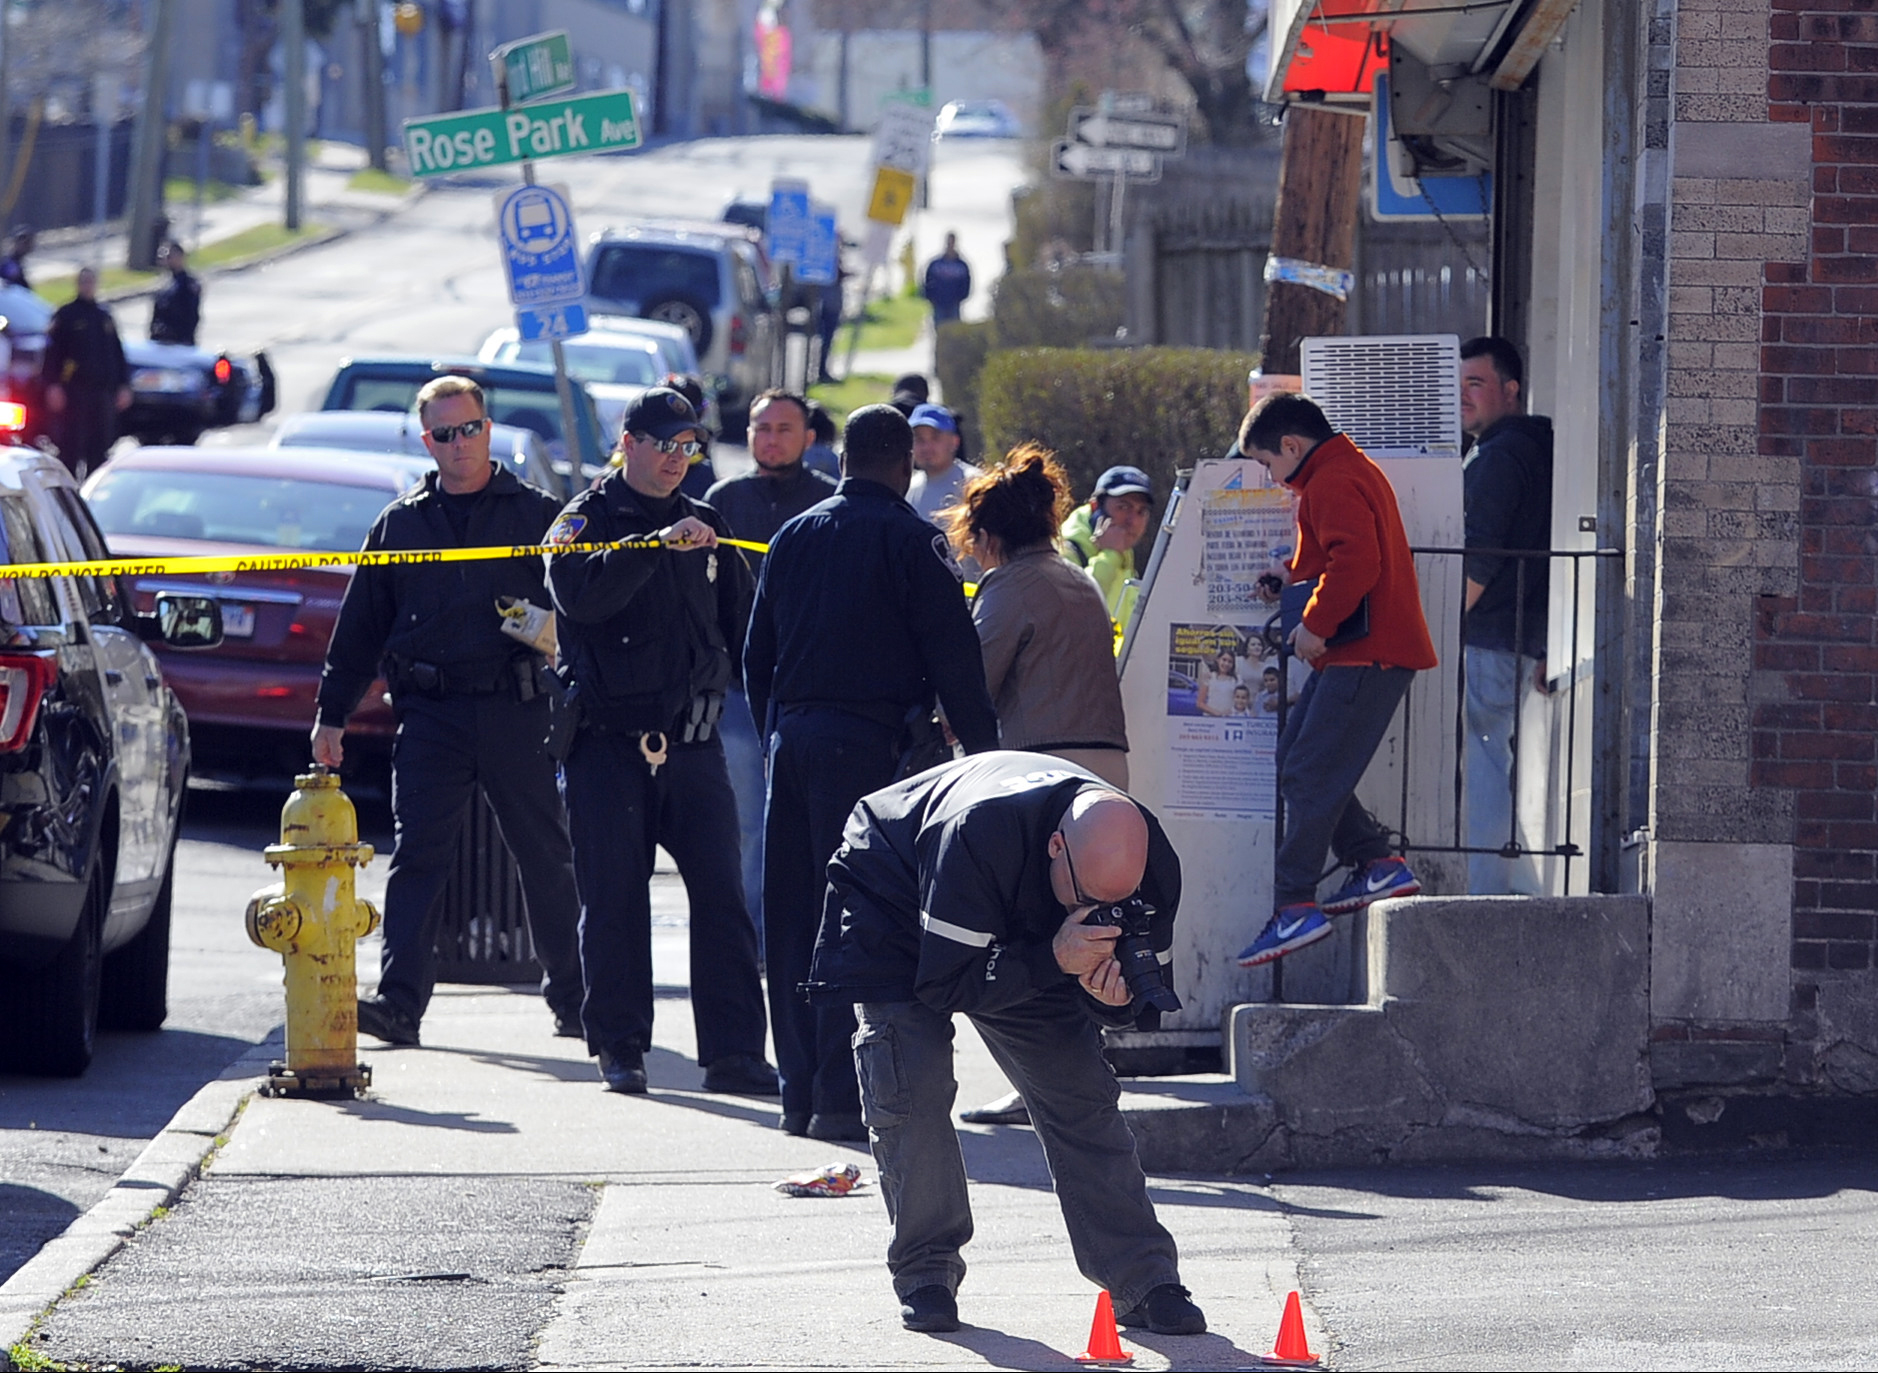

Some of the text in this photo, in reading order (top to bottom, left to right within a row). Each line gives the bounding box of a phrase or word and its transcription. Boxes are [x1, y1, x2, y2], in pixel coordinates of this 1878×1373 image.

[407, 107, 636, 172] Rose Park Ave
[536, 313, 568, 338] 24
[236, 556, 312, 571] CAUTION
